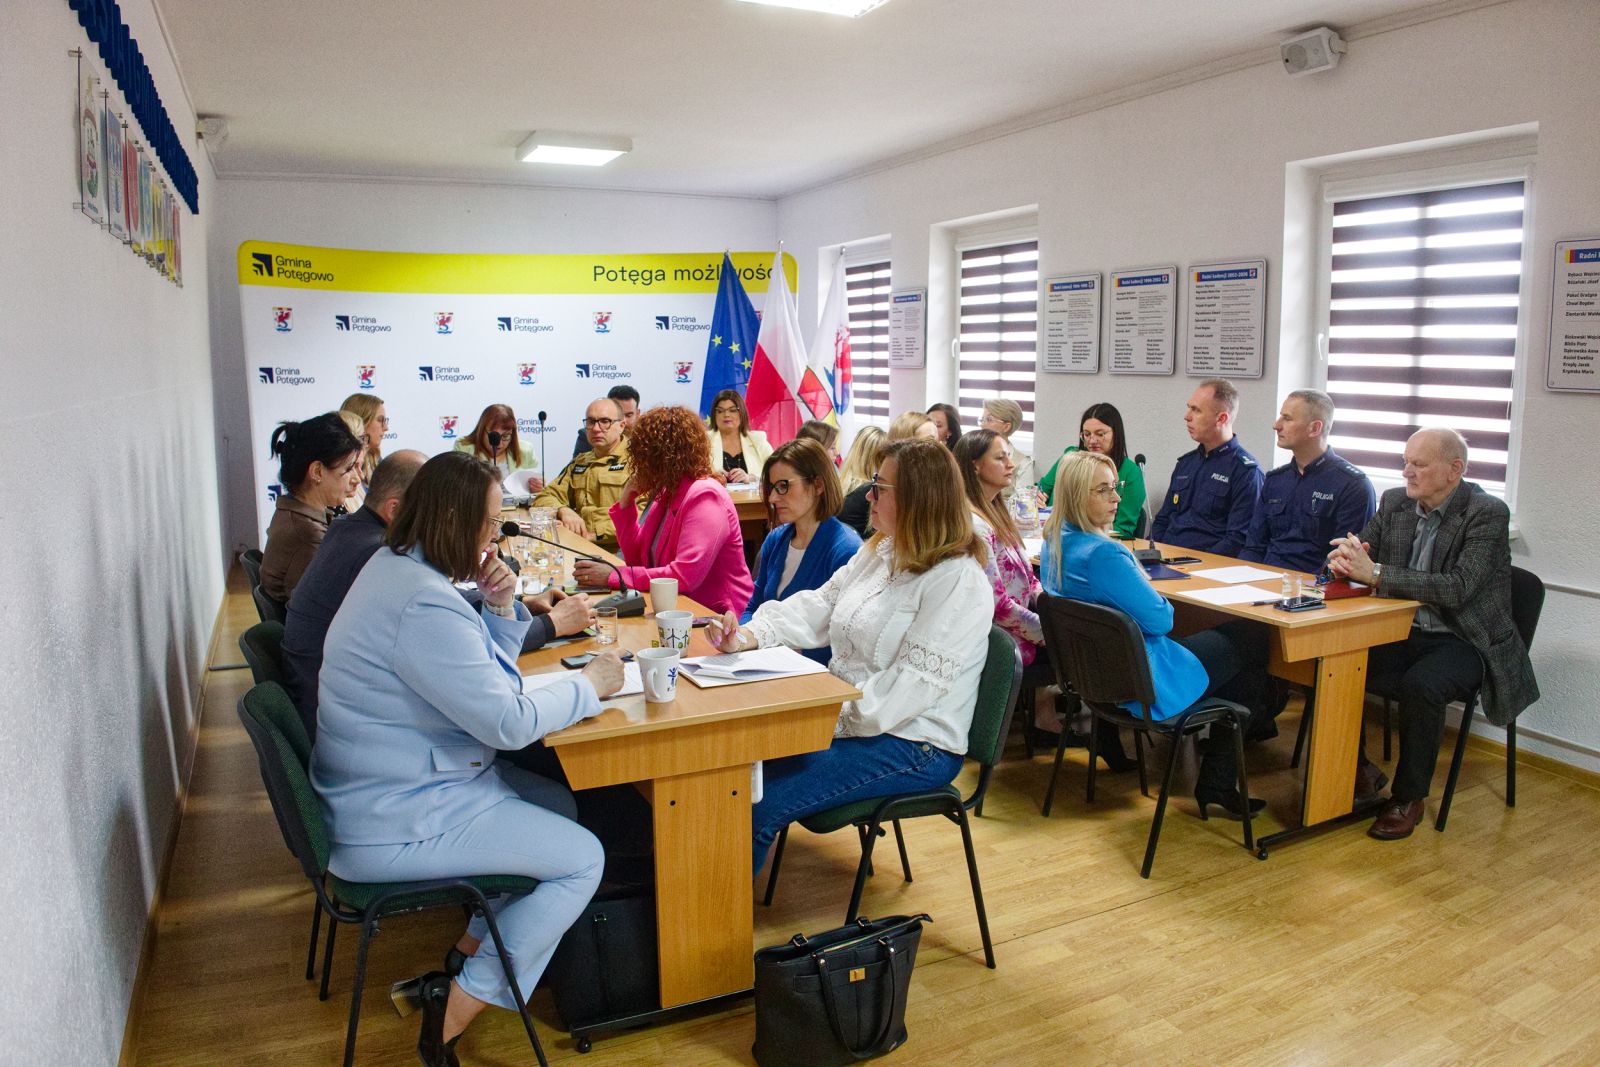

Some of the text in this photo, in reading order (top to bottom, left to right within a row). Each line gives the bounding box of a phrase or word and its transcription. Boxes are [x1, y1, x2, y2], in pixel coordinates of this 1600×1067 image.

[275, 255, 312, 268] Gmina
[277, 267, 334, 283] Potęgowo
[593, 265, 666, 286] Potęga
[351, 315, 377, 324] Gmina
[513, 316, 539, 324] Gmina
[671, 315, 696, 323] Gmina
[352, 324, 391, 333] Potęgowo
[514, 324, 554, 333] Potęgowo
[672, 323, 711, 332] Potęgowo
[275, 367, 300, 376] Gmina
[435, 366, 460, 374] Gmina
[592, 363, 617, 371] Gmina
[276, 375, 315, 385] Potęgowo
[435, 373, 474, 382] Potęgowo
[592, 371, 631, 380] Potęgowo
[517, 418, 543, 426] Gmin
[1211, 473, 1229, 483] POLICJA
[1312, 491, 1334, 500] POLICJA
